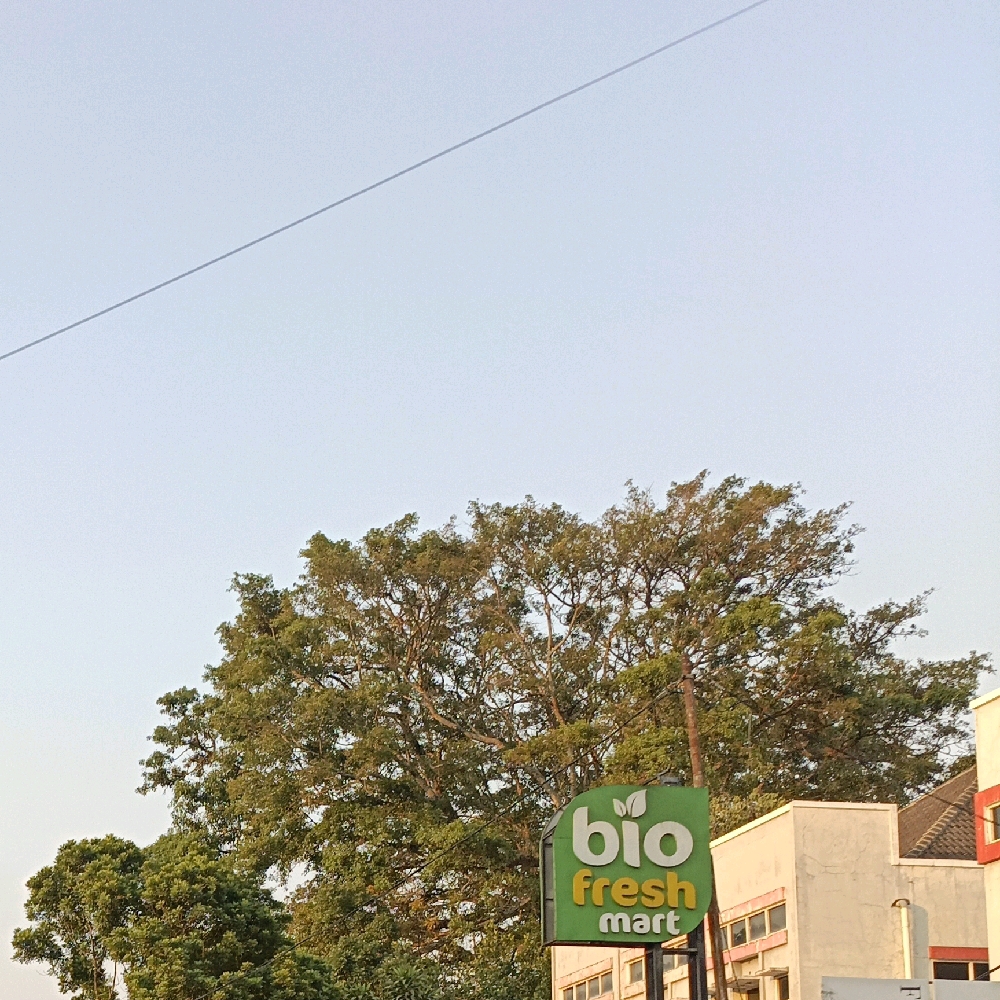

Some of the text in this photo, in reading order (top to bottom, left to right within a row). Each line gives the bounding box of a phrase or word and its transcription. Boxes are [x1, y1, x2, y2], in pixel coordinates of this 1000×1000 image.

[573, 792, 694, 868] bio
[573, 868, 697, 910] fresh
[599, 910, 681, 936] mart
